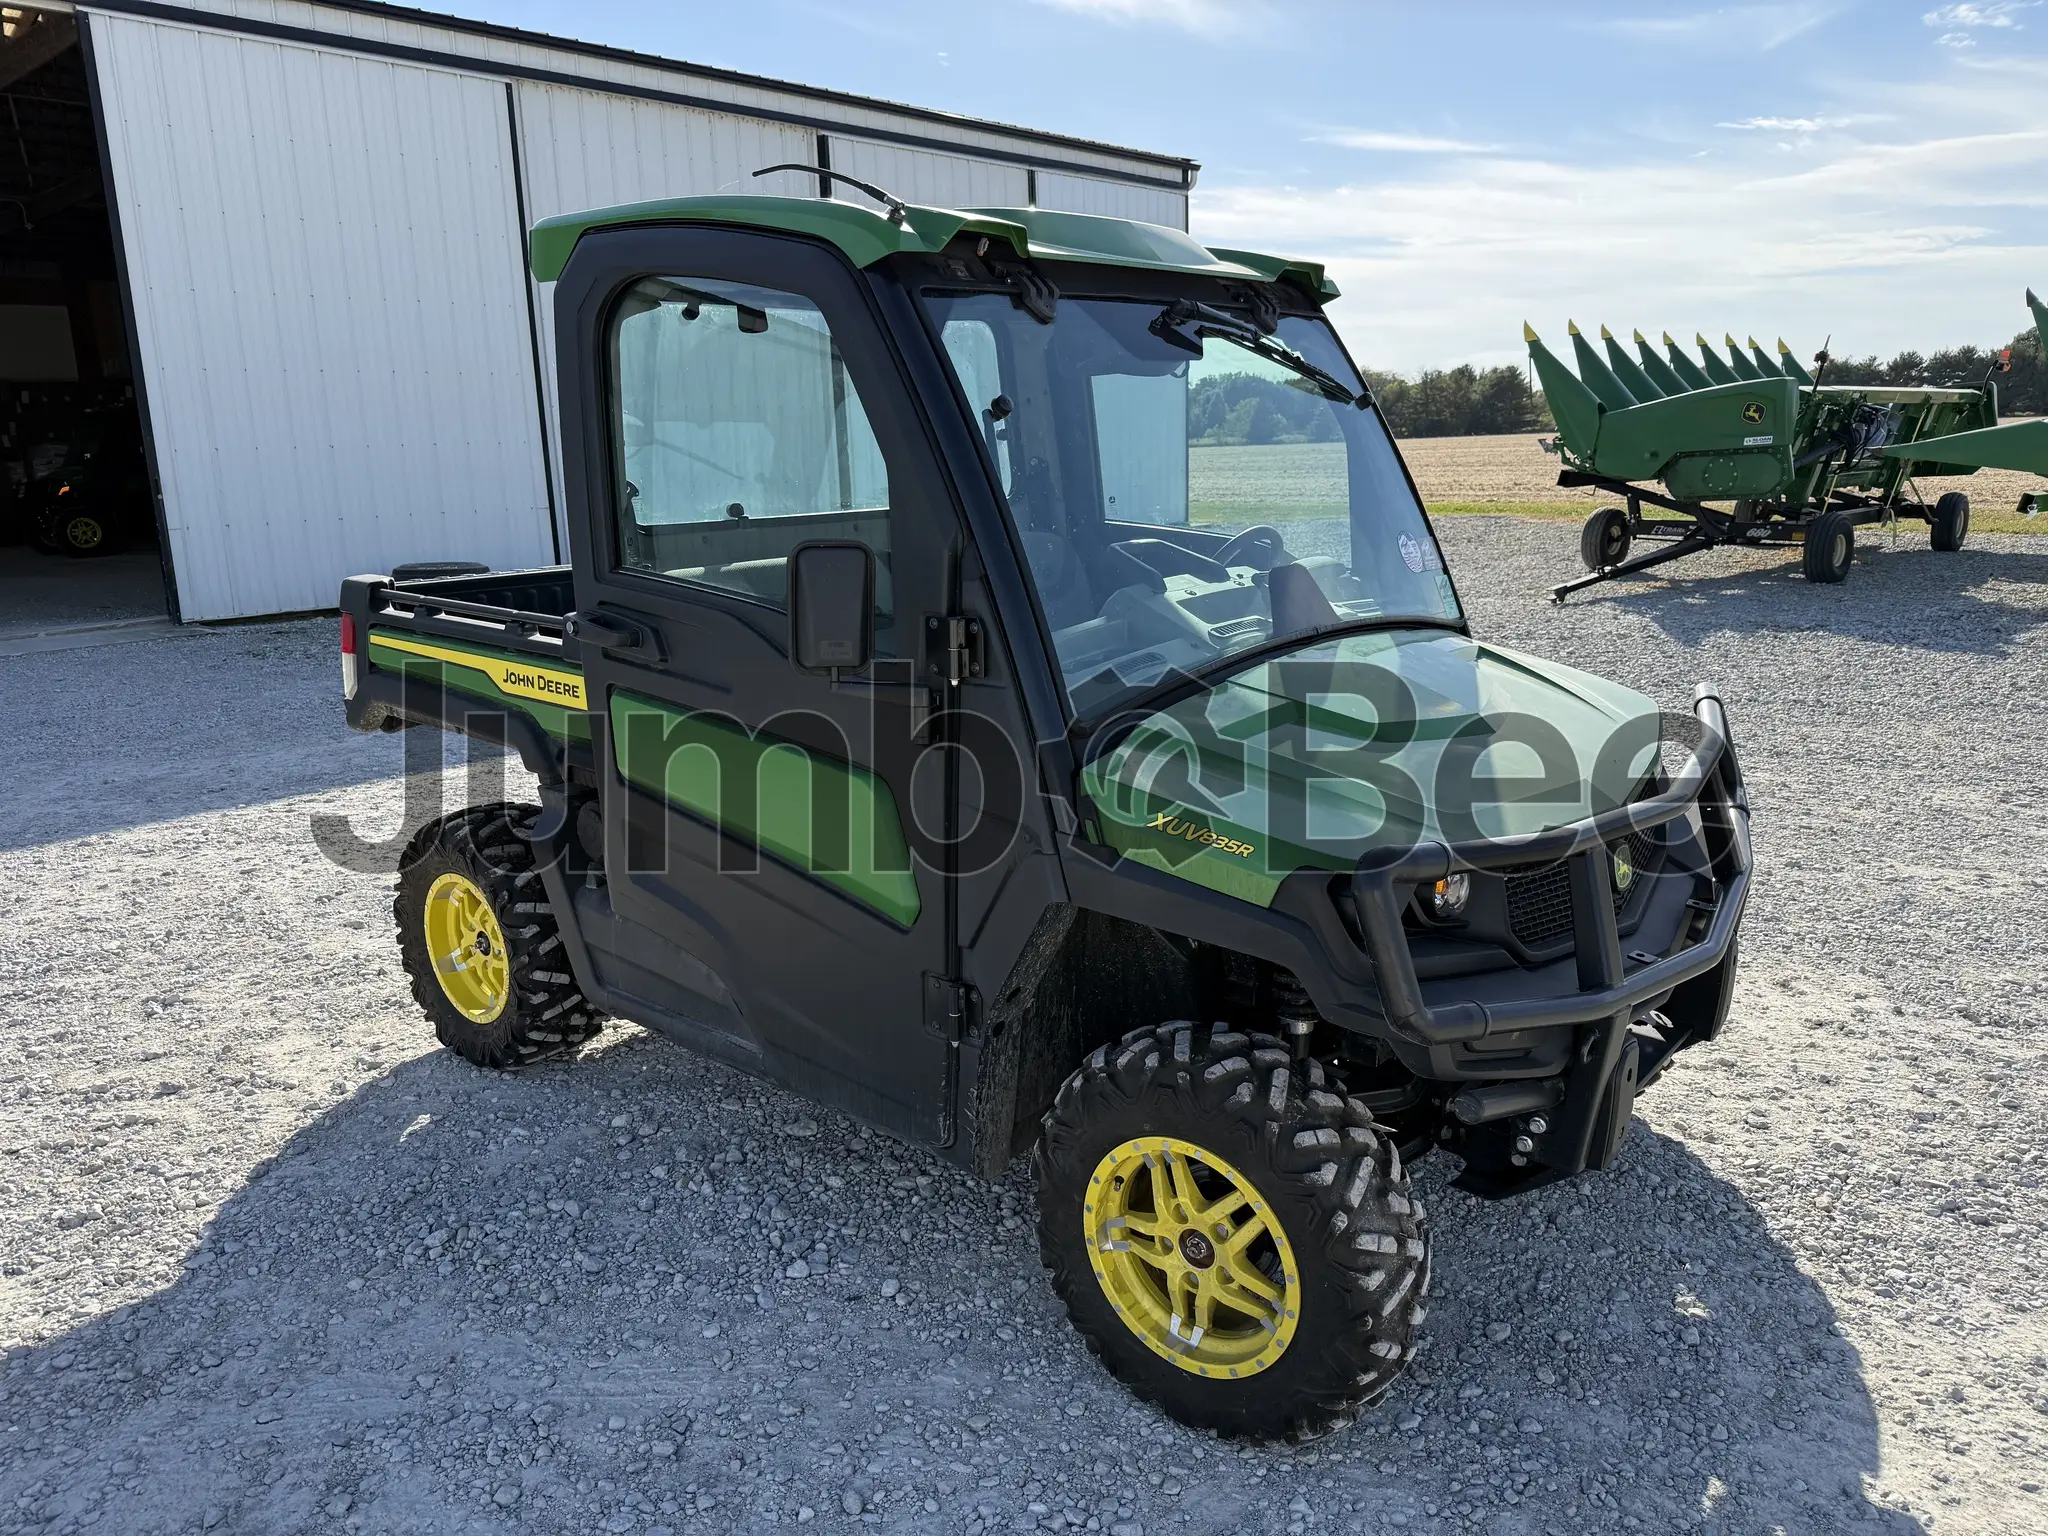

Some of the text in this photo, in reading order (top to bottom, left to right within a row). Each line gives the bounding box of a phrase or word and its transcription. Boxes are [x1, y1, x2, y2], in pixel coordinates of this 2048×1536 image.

[1746, 528, 1772, 538] 680
[503, 668, 580, 699] JOHN DEERE
[1144, 811, 1256, 858] XUV835R
